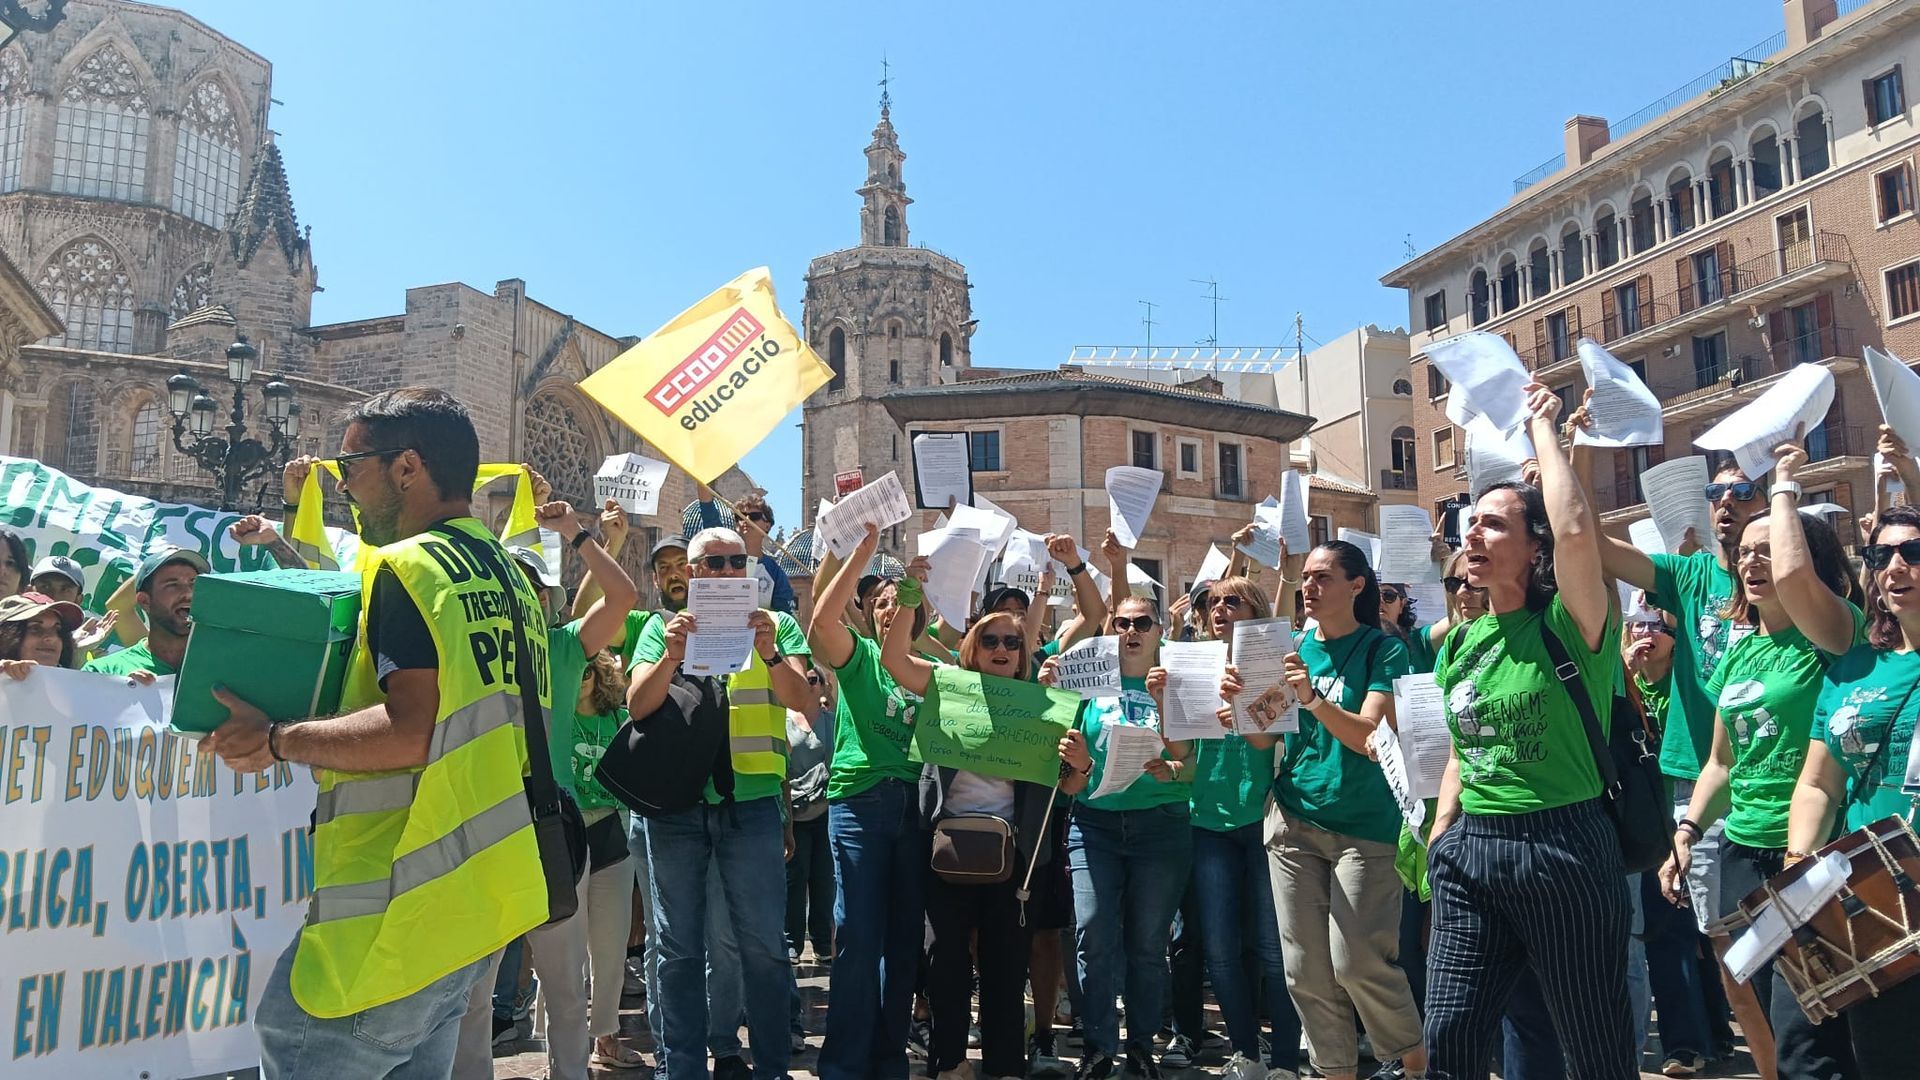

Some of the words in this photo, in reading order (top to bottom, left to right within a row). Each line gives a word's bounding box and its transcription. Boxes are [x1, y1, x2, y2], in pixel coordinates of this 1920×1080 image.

[654, 343, 728, 409] CCOO
[680, 334, 780, 431] educació
[418, 539, 536, 602] DOENT
[1057, 660, 1111, 676] DIRECTIU
[1060, 674, 1112, 690] DIMITINT
[0, 724, 52, 805] ET
[65, 723, 216, 804] EDUQUEM
[125, 833, 267, 922] OBERTA,
[12, 969, 67, 1062] EN
[79, 914, 252, 1052] VALENCIÀ
